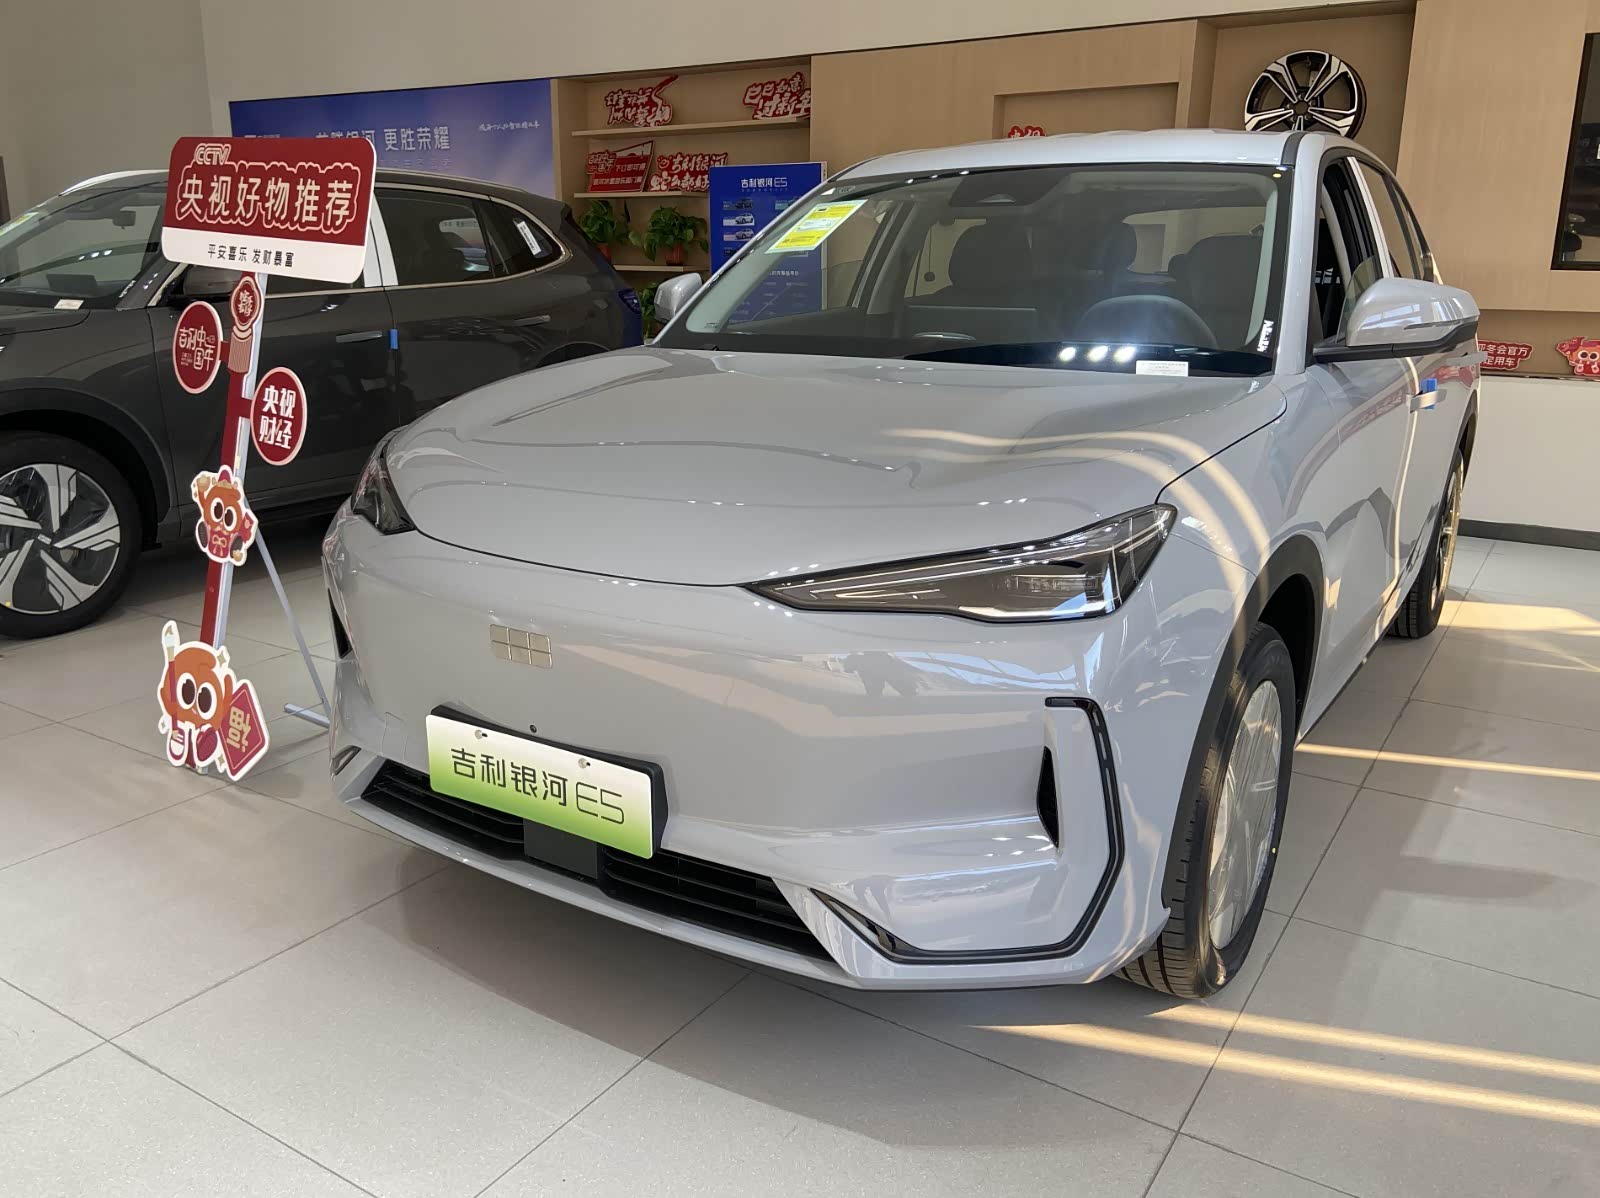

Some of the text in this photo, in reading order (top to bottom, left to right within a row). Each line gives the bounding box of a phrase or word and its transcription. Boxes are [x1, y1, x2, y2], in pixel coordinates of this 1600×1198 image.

[195, 144, 230, 165] CCTV
[384, 126, 450, 151] 更胜荣耀
[181, 173, 353, 226] 央视好物推荐
[208, 244, 294, 267] 平安喜乐 发财暴富
[262, 385, 296, 419] 央视
[259, 415, 292, 449] 财经
[226, 706, 251, 753] 福
